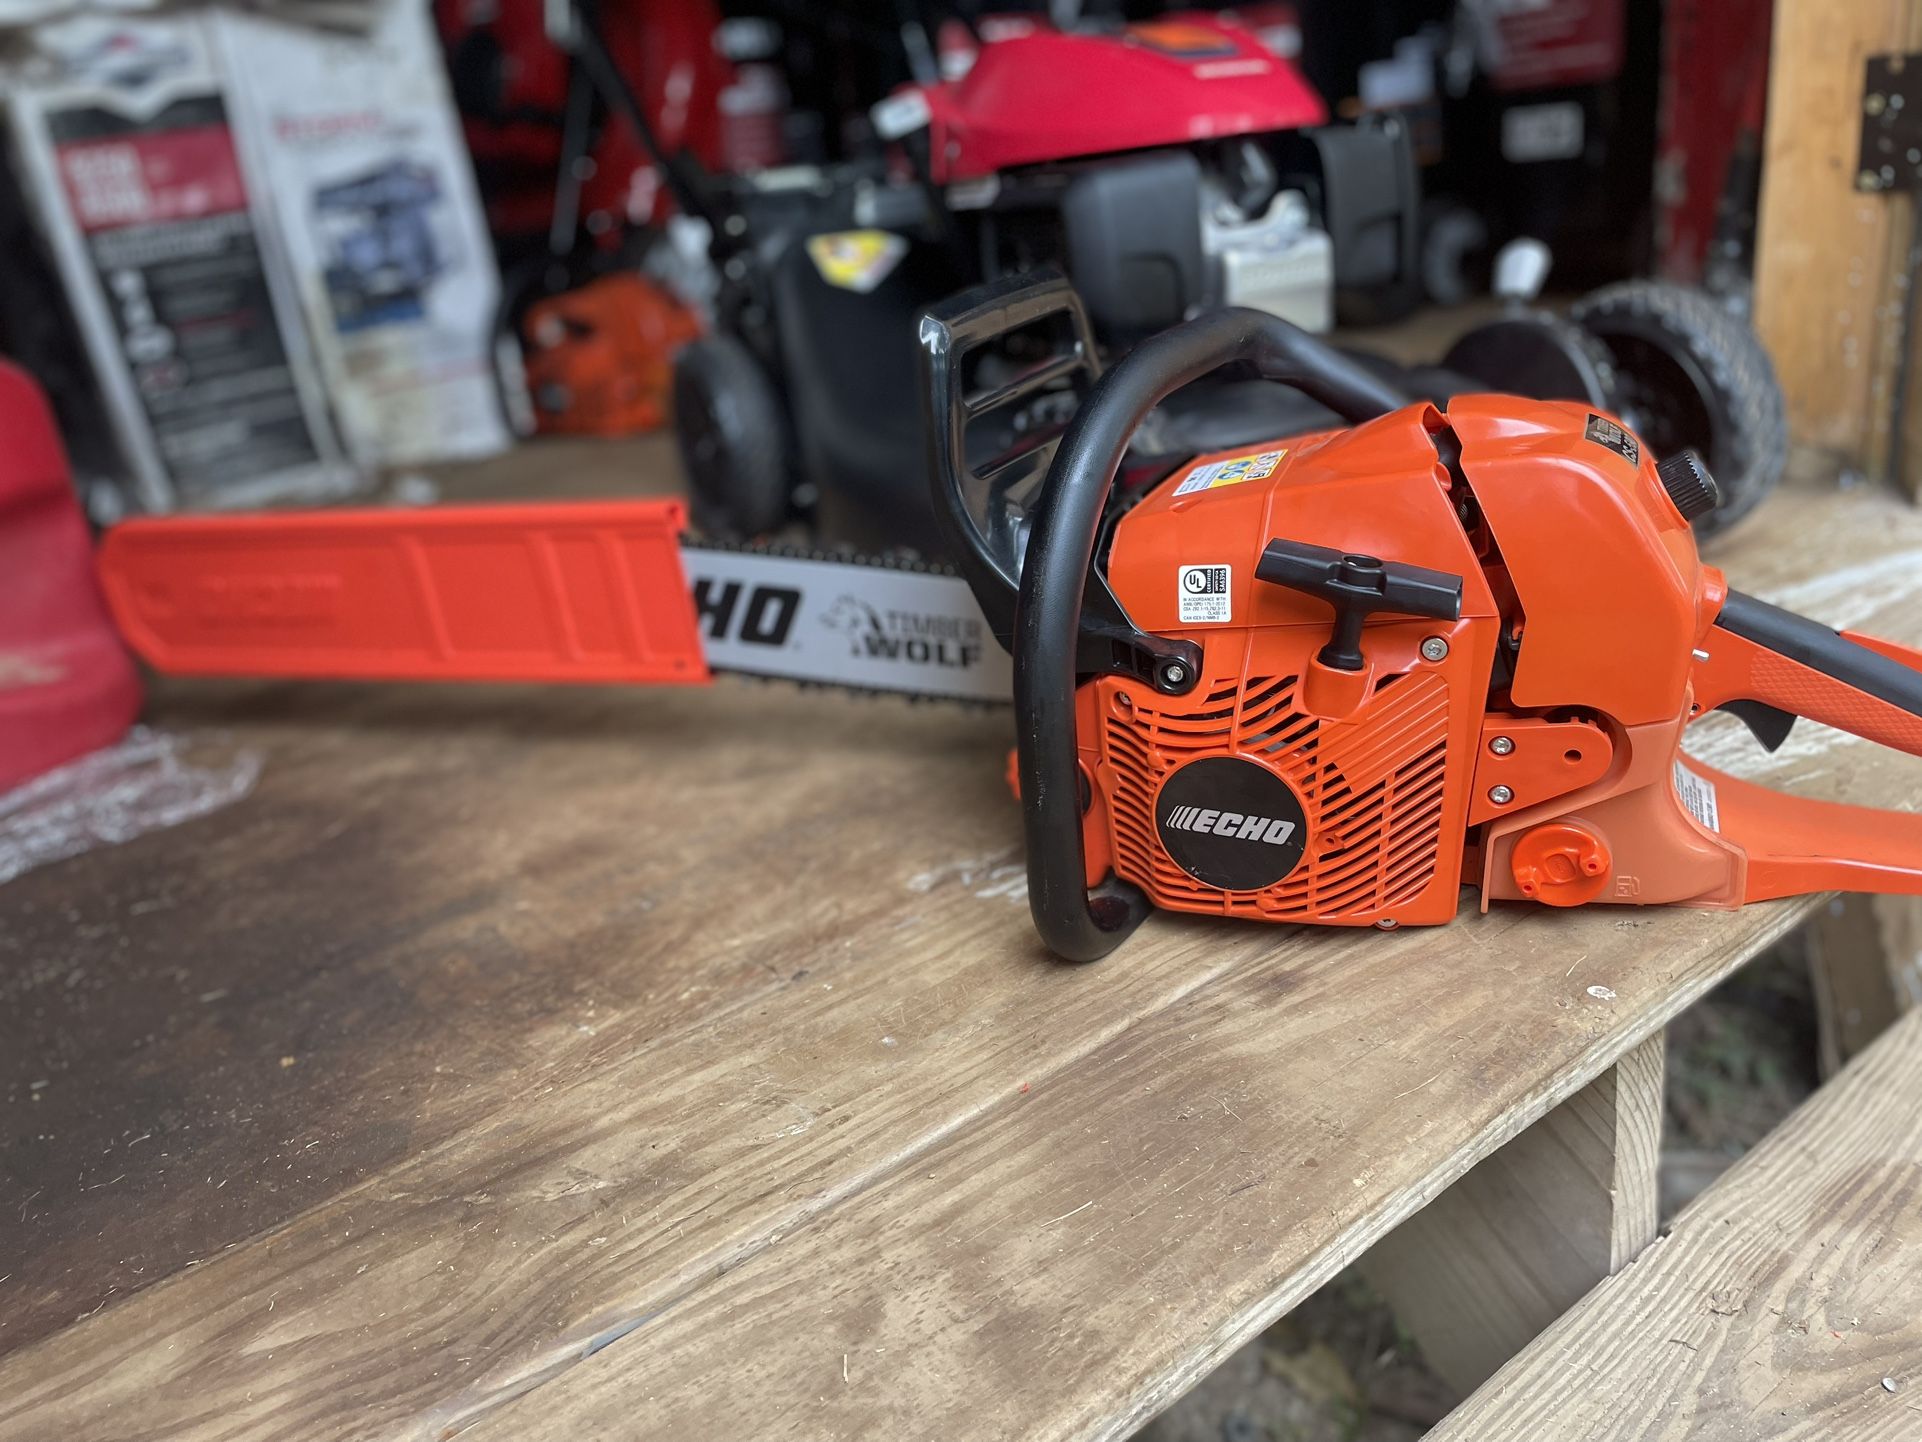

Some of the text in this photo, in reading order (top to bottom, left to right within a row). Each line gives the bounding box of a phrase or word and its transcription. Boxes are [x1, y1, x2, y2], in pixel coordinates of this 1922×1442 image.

[1189, 574, 1202, 588] UL
[864, 636, 982, 667] WOLF
[1190, 808, 1296, 845] ECHO
